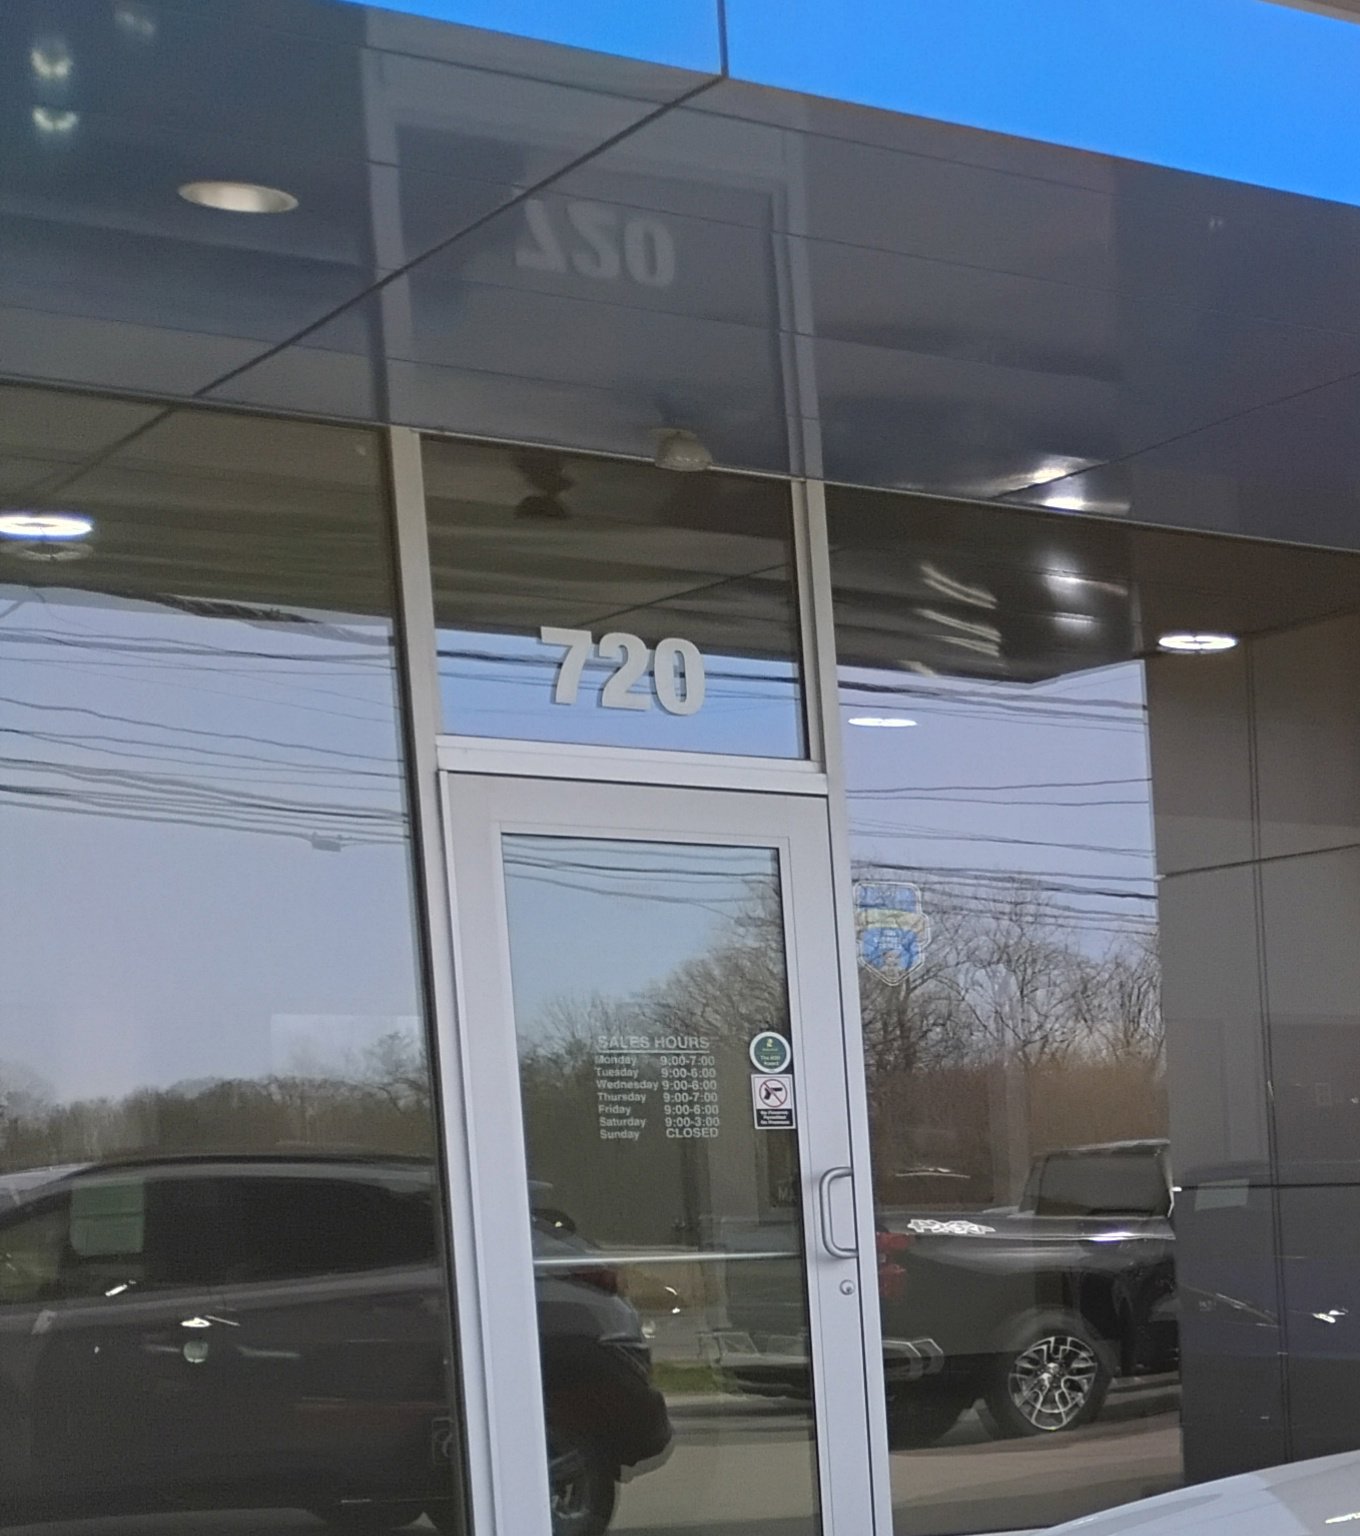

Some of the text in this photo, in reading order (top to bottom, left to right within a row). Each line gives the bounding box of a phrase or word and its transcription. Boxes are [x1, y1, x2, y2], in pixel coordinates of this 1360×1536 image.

[539, 625, 705, 716] 720
[598, 1036, 710, 1049] SALES HOURS
[594, 1055, 715, 1066] Monday 9:00-7:00
[594, 1067, 716, 1078] Tuesday 9:00-6:00
[596, 1080, 717, 1091] Wednesday 9:00-6:00
[597, 1092, 718, 1104] Thursday 9:00-7:00
[598, 1104, 719, 1116] Friday 9:00-6:00
[599, 1117, 720, 1128] Saturday 9:00-3:00
[599, 1128, 719, 1141] Sunday CLOSED
